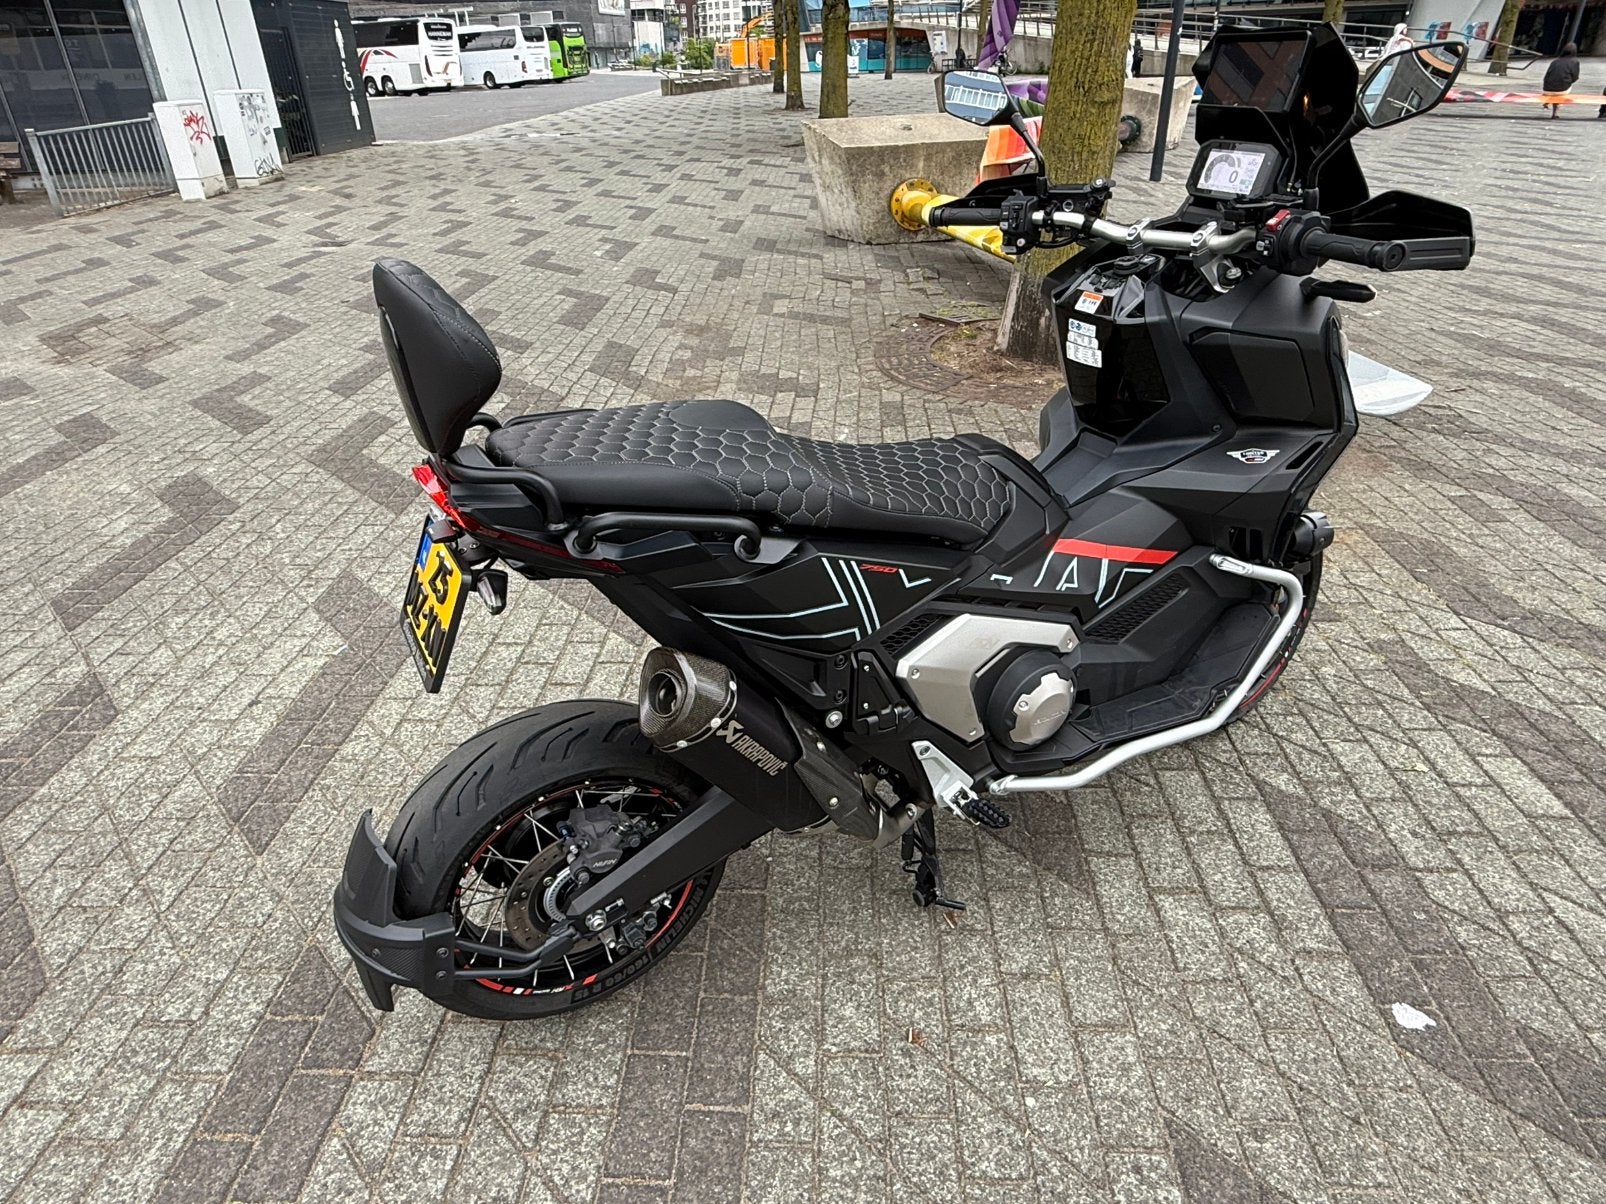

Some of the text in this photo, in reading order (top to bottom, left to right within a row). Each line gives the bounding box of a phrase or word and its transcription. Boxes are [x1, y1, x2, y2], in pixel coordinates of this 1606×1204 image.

[859, 562, 899, 574] 750
[655, 887, 706, 953] MICHELIN
[605, 954, 649, 988] 160/60
